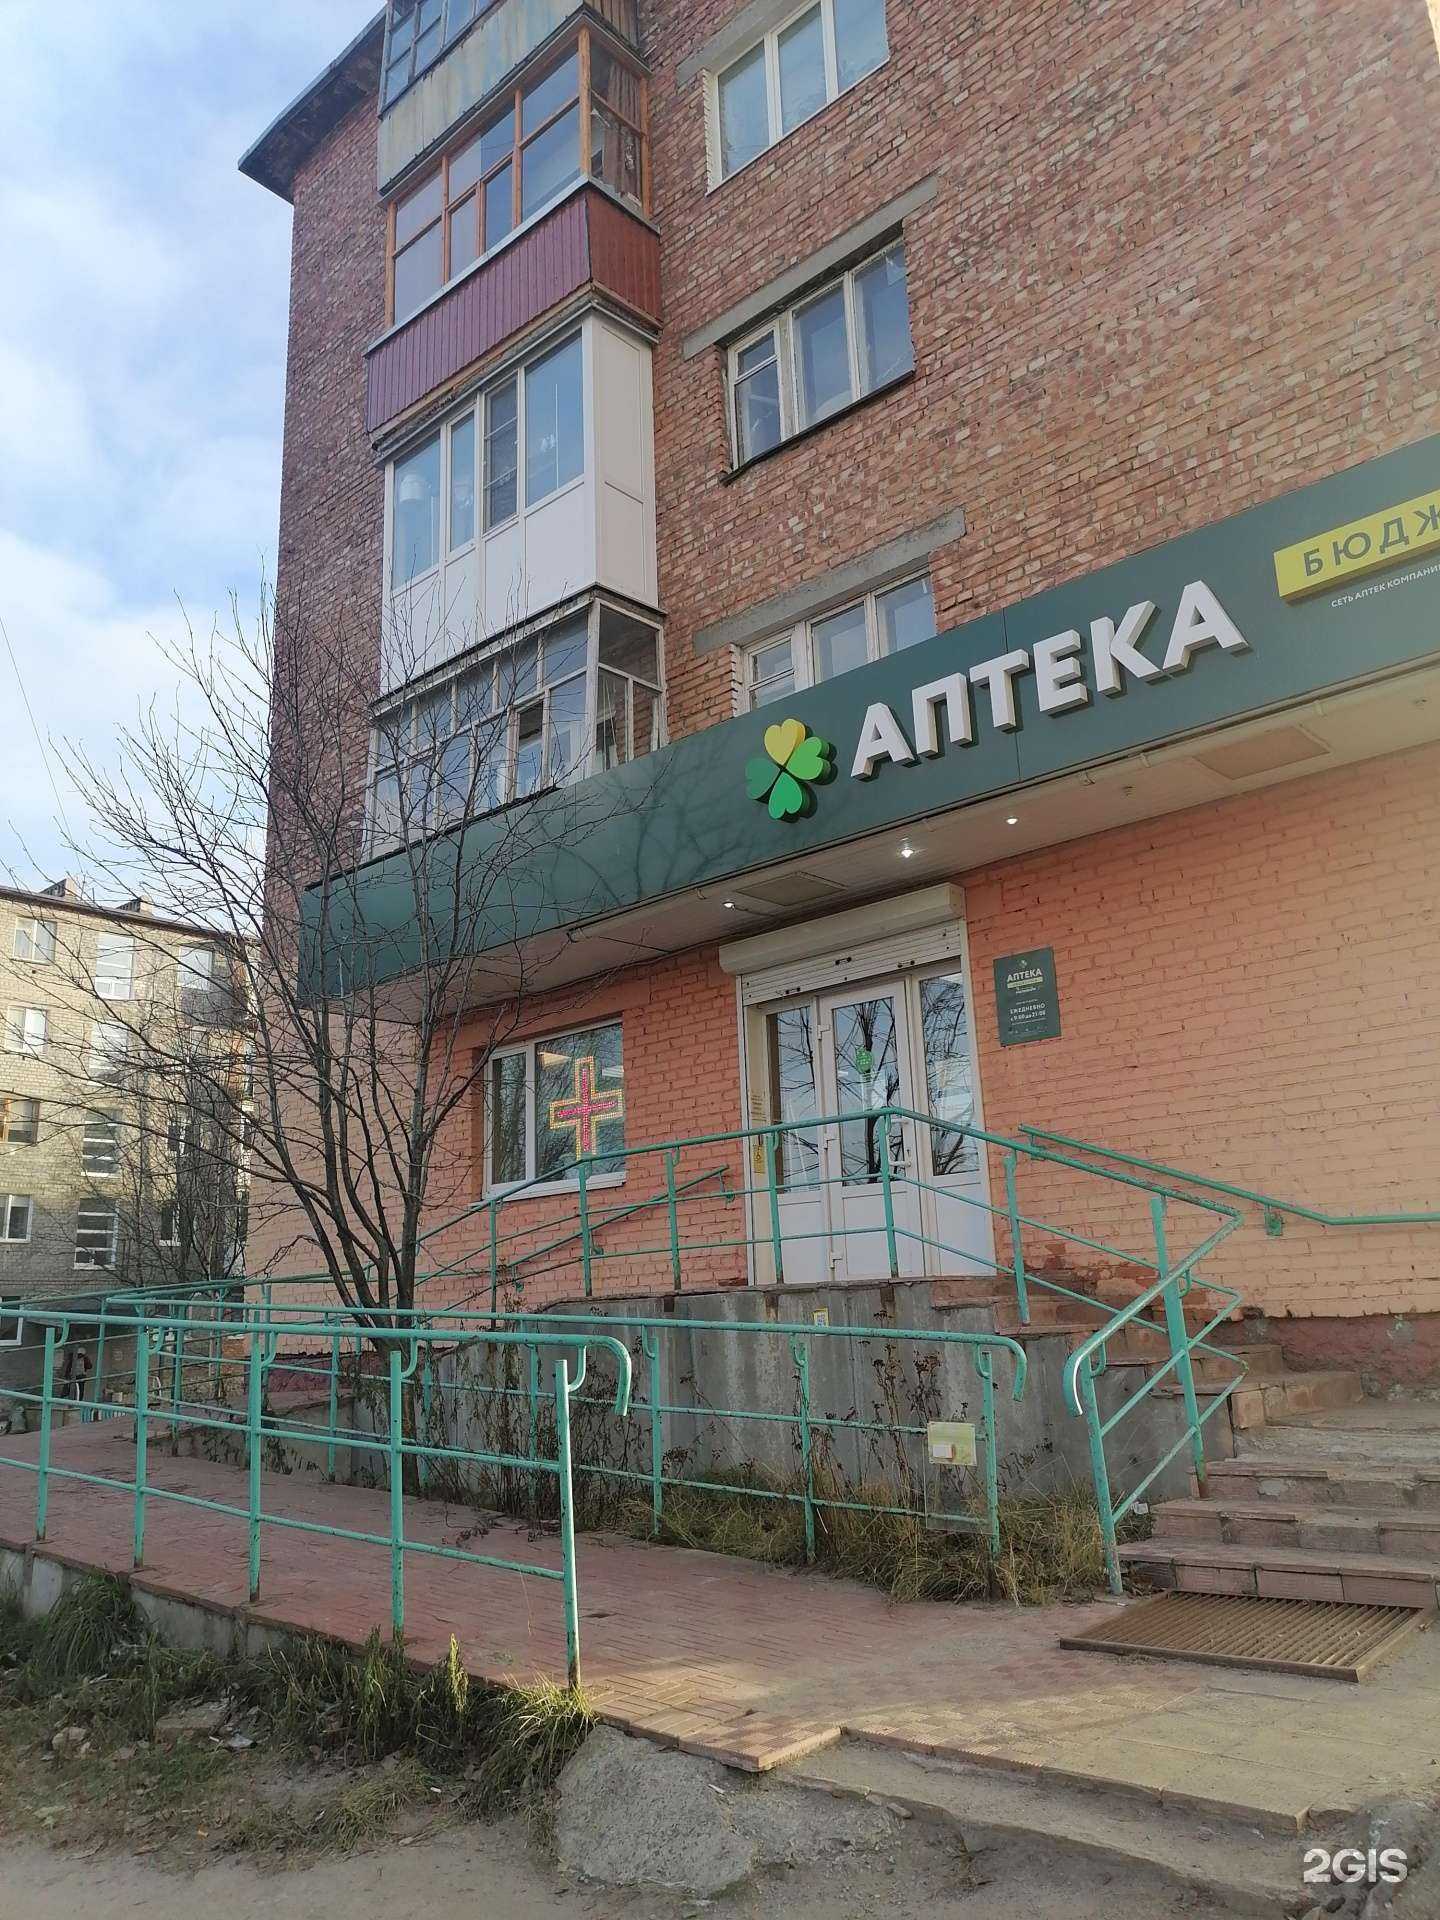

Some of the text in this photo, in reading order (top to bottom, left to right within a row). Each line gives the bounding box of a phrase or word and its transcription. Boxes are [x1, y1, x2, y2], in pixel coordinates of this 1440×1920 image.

[1303, 505, 1440, 576] БЮДЖ
[1331, 595, 1354, 608] СЕТЬ
[1355, 583, 1386, 600] АПТЕК
[850, 580, 1249, 779] АПТЕКА
[1007, 968, 1043, 982] АПТЕКА
